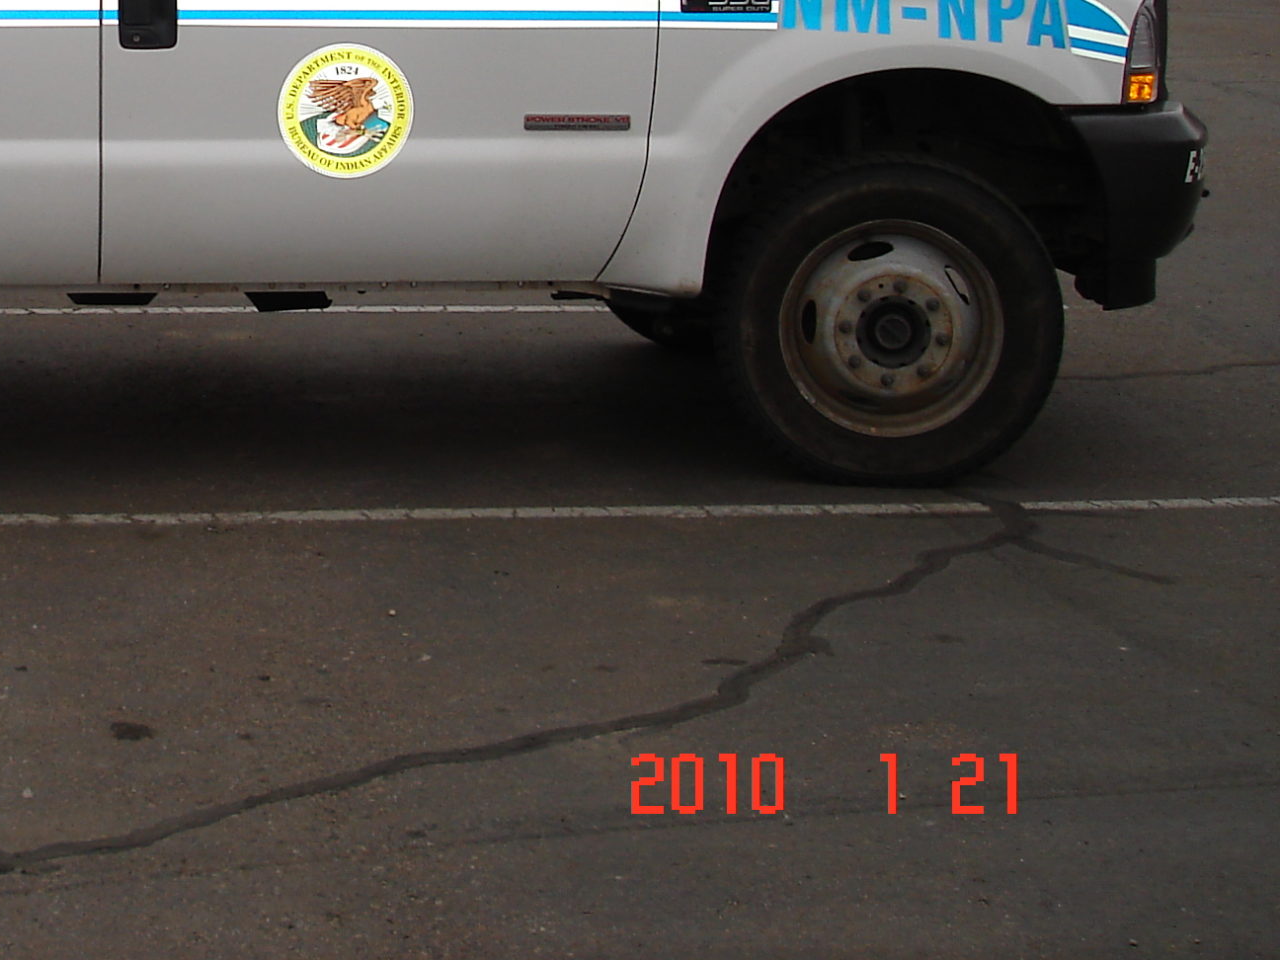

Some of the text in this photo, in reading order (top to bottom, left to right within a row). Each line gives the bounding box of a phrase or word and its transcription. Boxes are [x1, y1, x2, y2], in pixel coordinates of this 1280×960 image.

[288, 51, 352, 97] DEPARTMENT
[382, 67, 406, 119] INTERIOR
[335, 66, 359, 75] 1824
[288, 126, 403, 171] BUREAU OF INDIAN AFFAIRS
